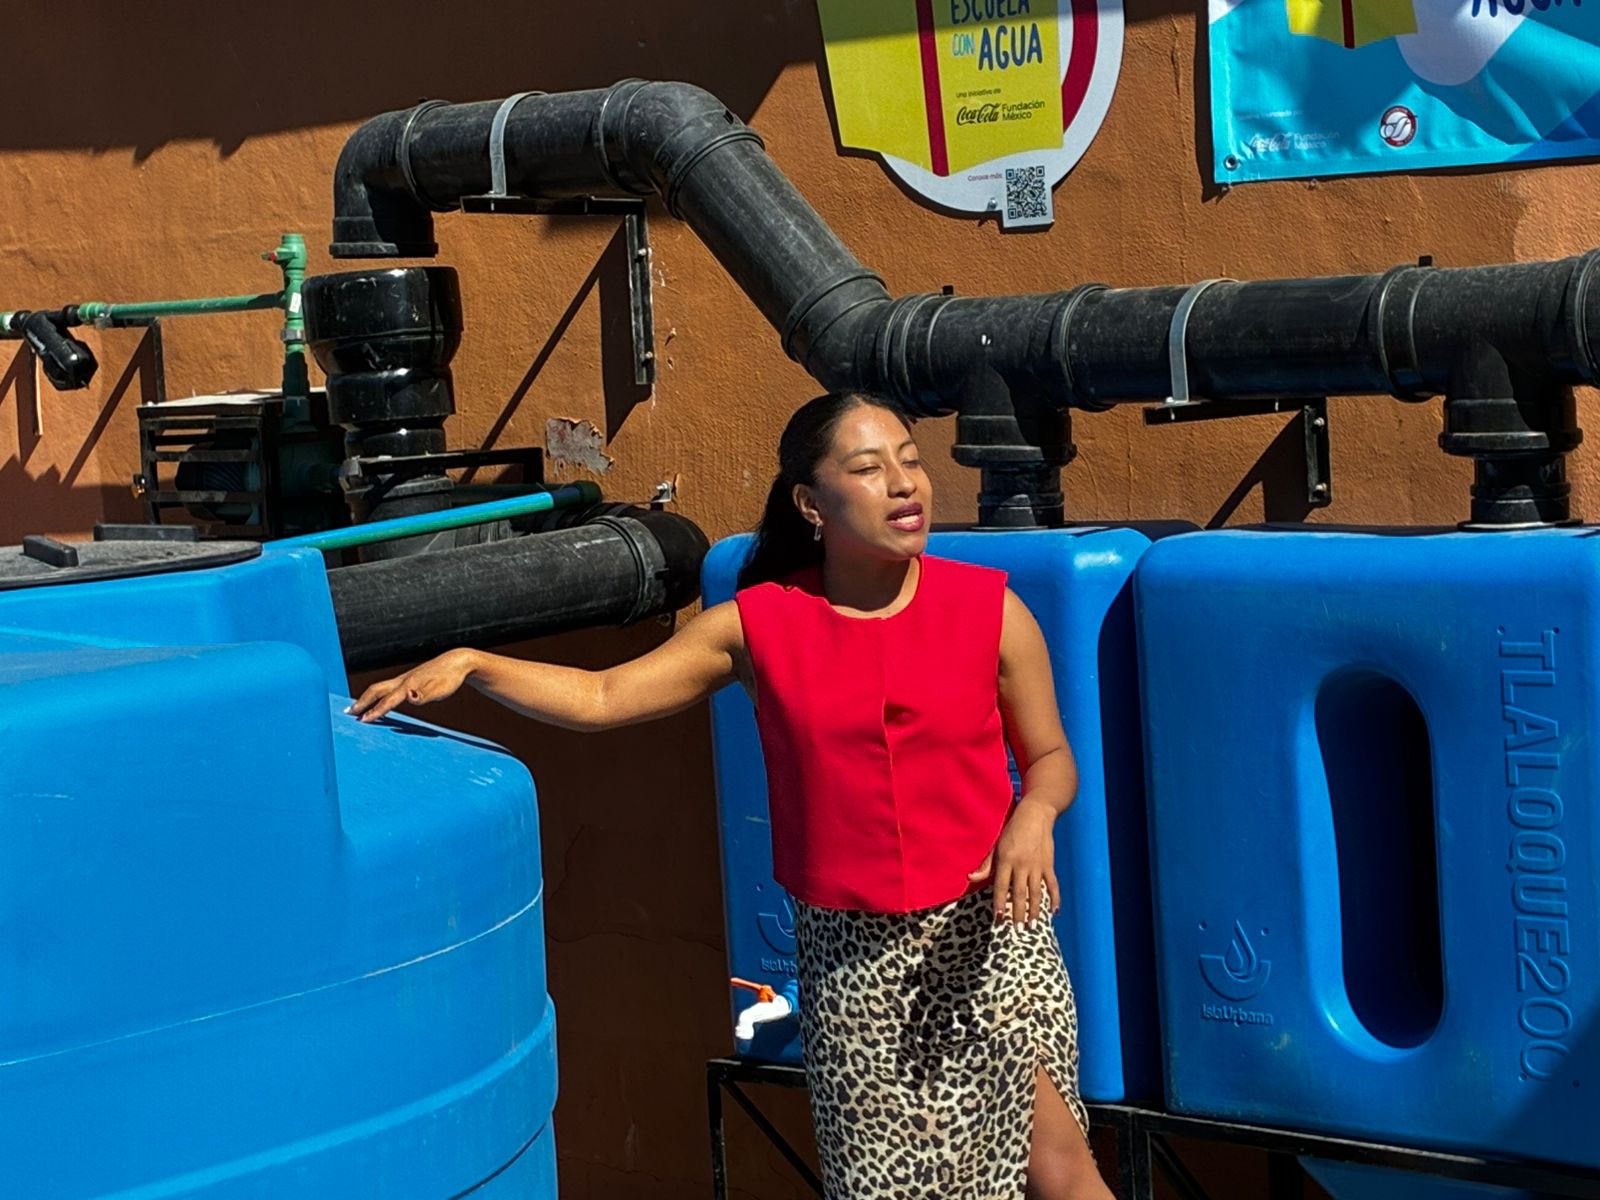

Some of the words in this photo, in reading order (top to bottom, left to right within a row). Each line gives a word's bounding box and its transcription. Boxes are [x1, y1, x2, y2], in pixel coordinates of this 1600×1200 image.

[952, 33, 975, 56] CON
[978, 23, 1043, 71] AGUA
[1002, 100, 1046, 112] Fundación
[1002, 111, 1032, 121] México
[761, 958, 798, 977] IslaUrb
